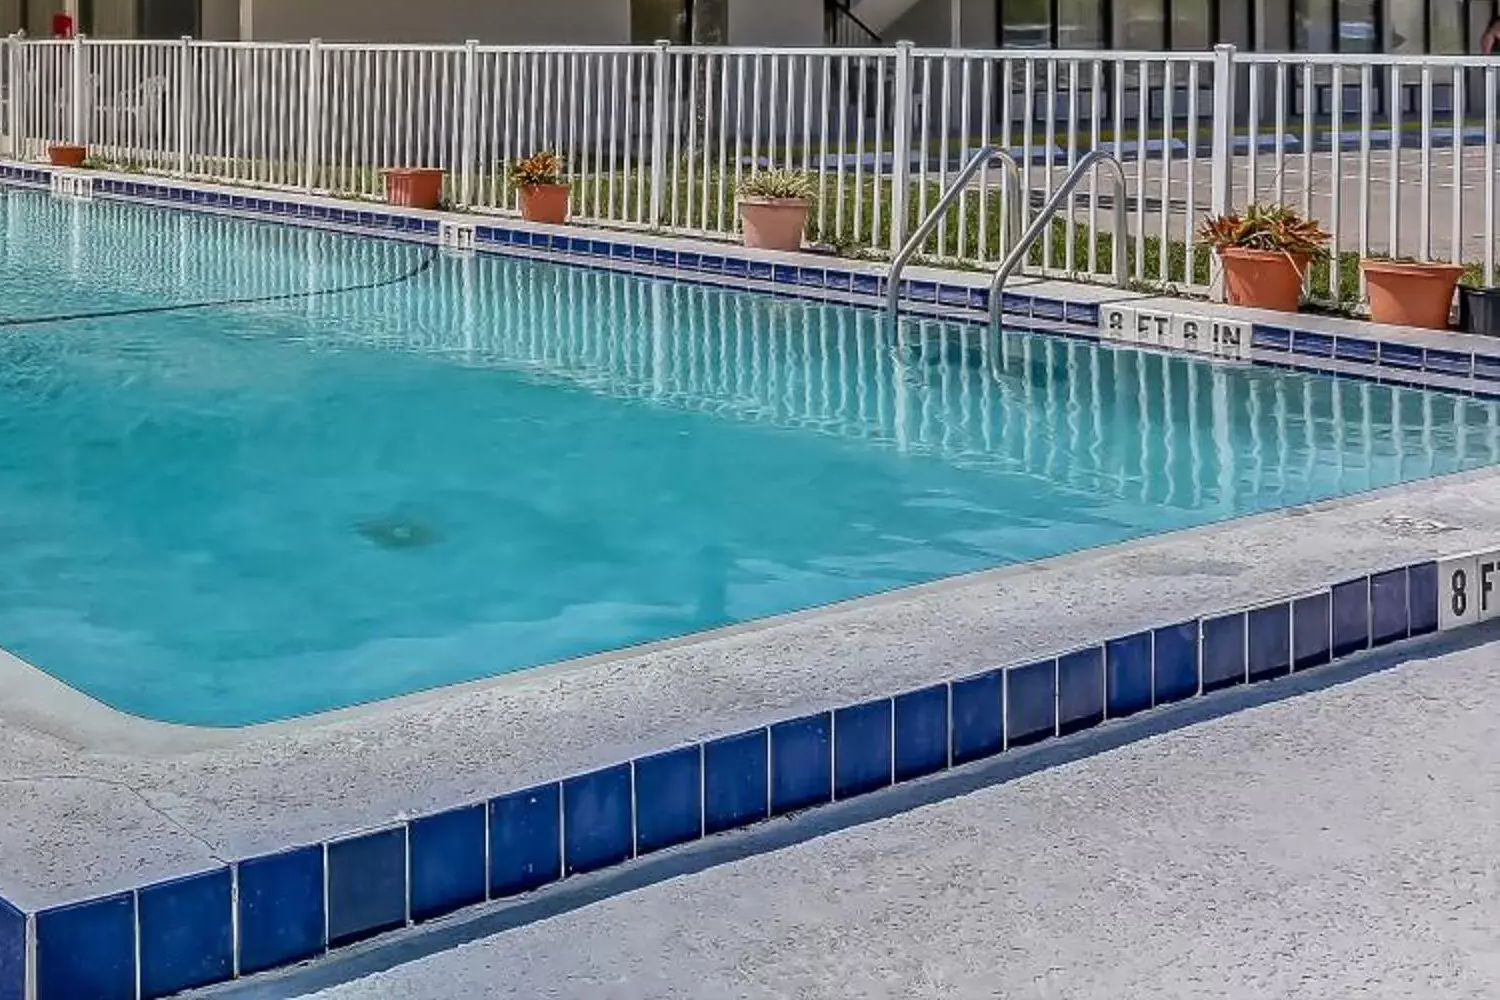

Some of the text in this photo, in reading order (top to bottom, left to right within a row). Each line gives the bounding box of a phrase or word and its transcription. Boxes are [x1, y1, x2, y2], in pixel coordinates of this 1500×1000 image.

[457, 227, 473, 243] FT
[1137, 315, 1169, 336] FT
[1212, 323, 1241, 345] IN
[1451, 561, 1500, 616] 8 F
